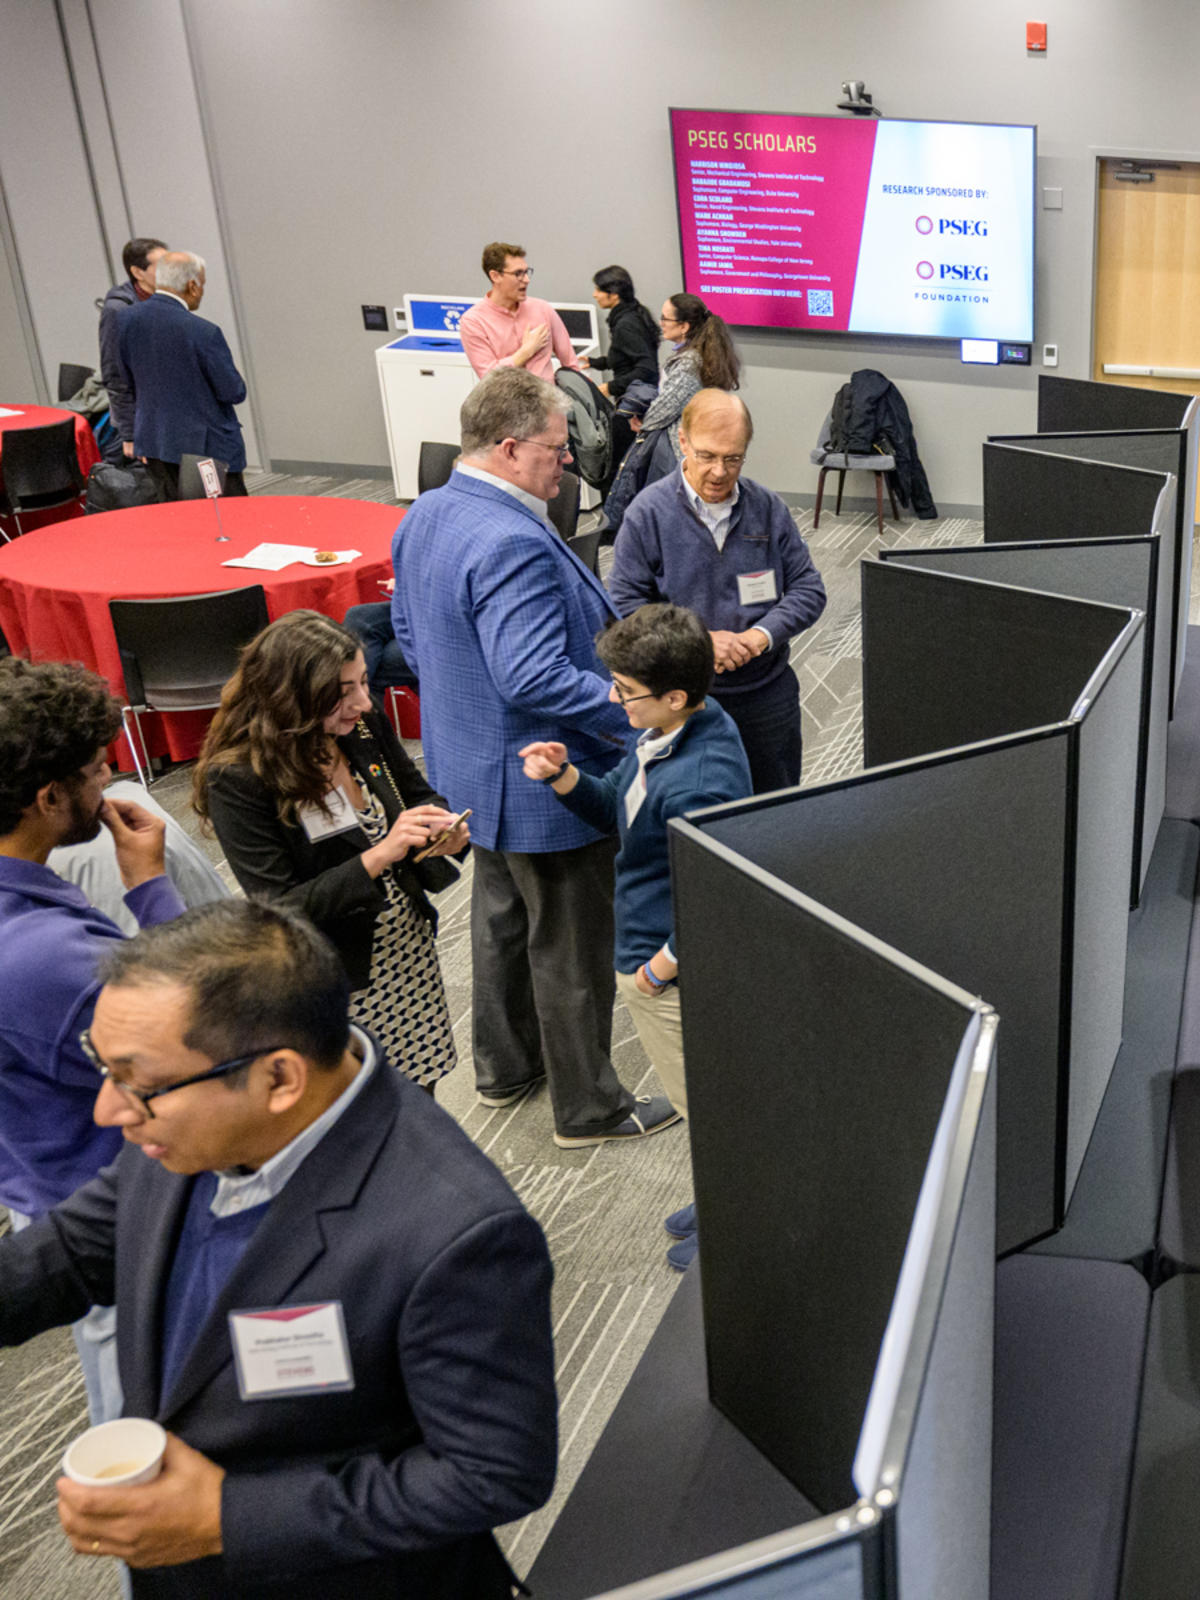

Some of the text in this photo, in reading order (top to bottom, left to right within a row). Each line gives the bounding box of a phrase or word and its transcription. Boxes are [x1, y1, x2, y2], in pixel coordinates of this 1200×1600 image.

[688, 130, 817, 153] PSEG SCHOLARS
[882, 184, 989, 198] RESEARCH SPONSORED BY:
[939, 218, 988, 236] PSEG
[939, 263, 988, 281] PSEG
[733, 287, 772, 295] PRESENTATION
[914, 292, 989, 303] FOUNDATION
